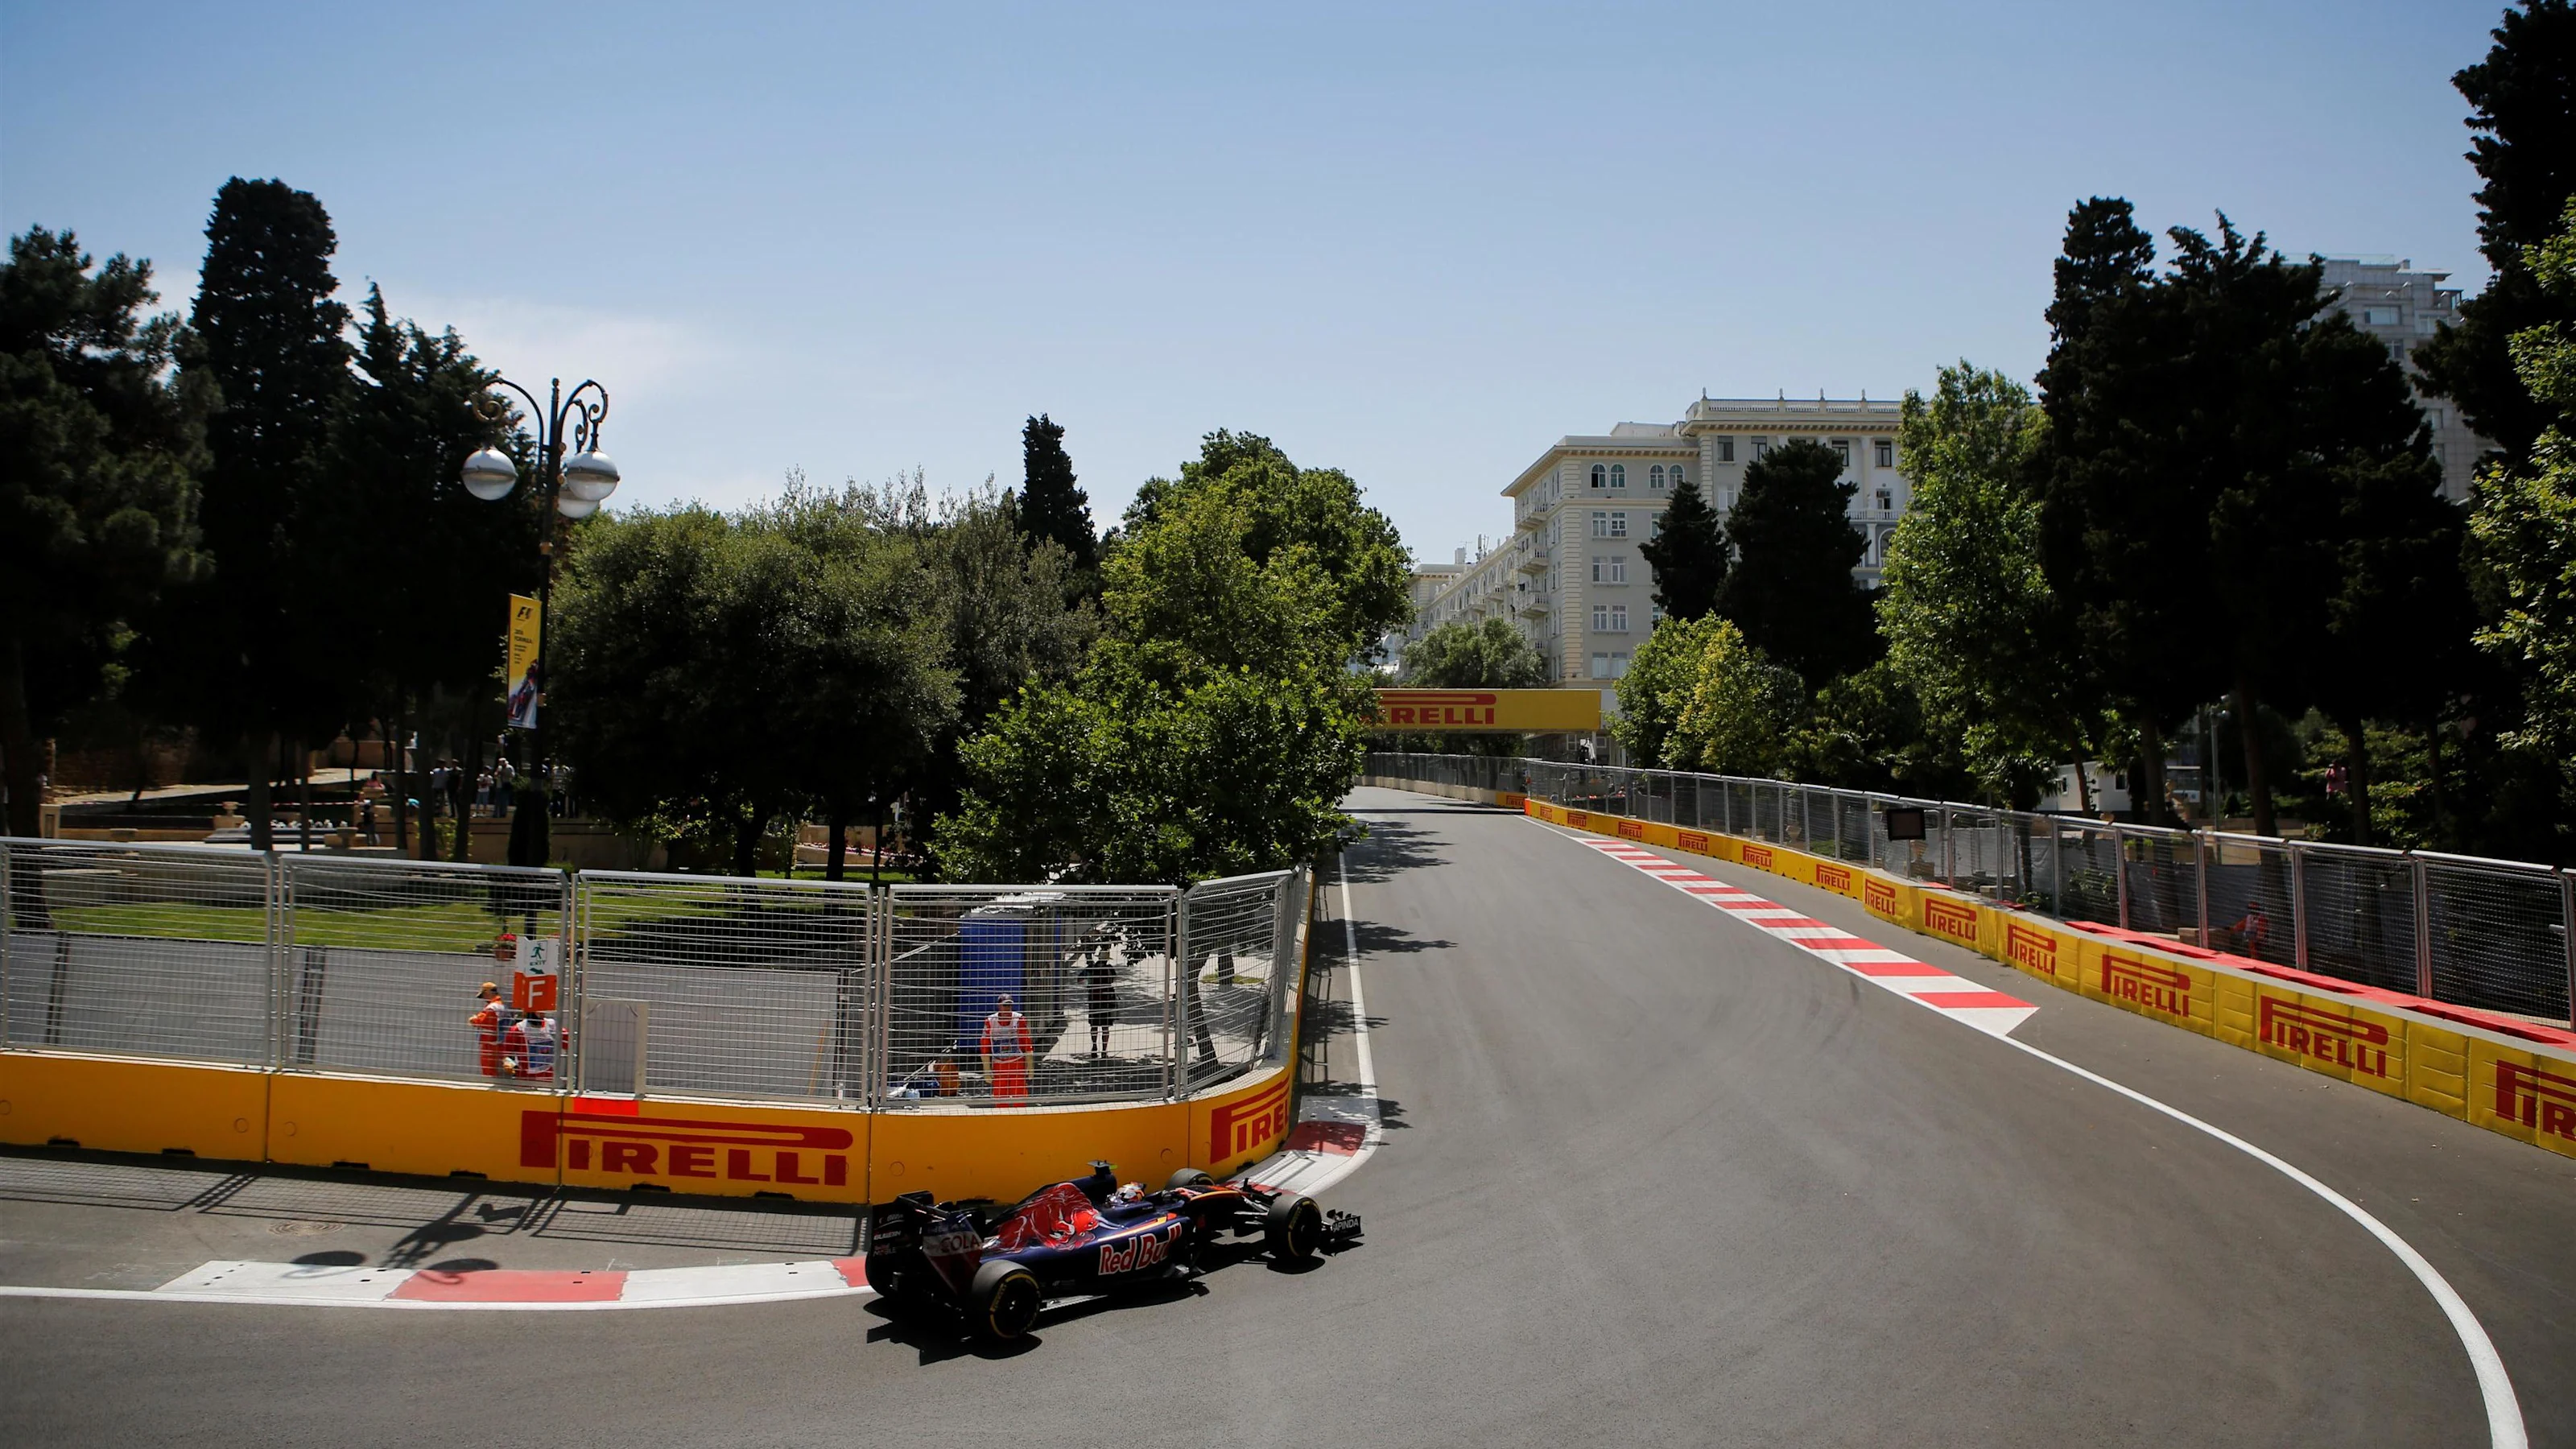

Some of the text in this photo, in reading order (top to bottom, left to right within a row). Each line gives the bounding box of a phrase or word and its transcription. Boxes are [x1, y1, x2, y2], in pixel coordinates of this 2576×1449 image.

[1360, 693, 1496, 724] RELLI
[1619, 821, 1642, 838] PIRELLI
[1678, 832, 1708, 852] PIRELLI
[1743, 845, 1772, 867] PIRELLI
[1816, 864, 1850, 890] PIRELLI
[1865, 879, 1895, 915] PIRELLI
[1926, 898, 1976, 941] PIRELLI
[2008, 923, 2057, 975] PIRELLI
[528, 980, 546, 1009] F
[2102, 954, 2191, 1017] PIRELLI
[2260, 995, 2388, 1078] PIRELLI
[521, 1111, 853, 1186] PIRELLI
[941, 1234, 980, 1253] COLA
[1098, 1236, 1137, 1275] Red
